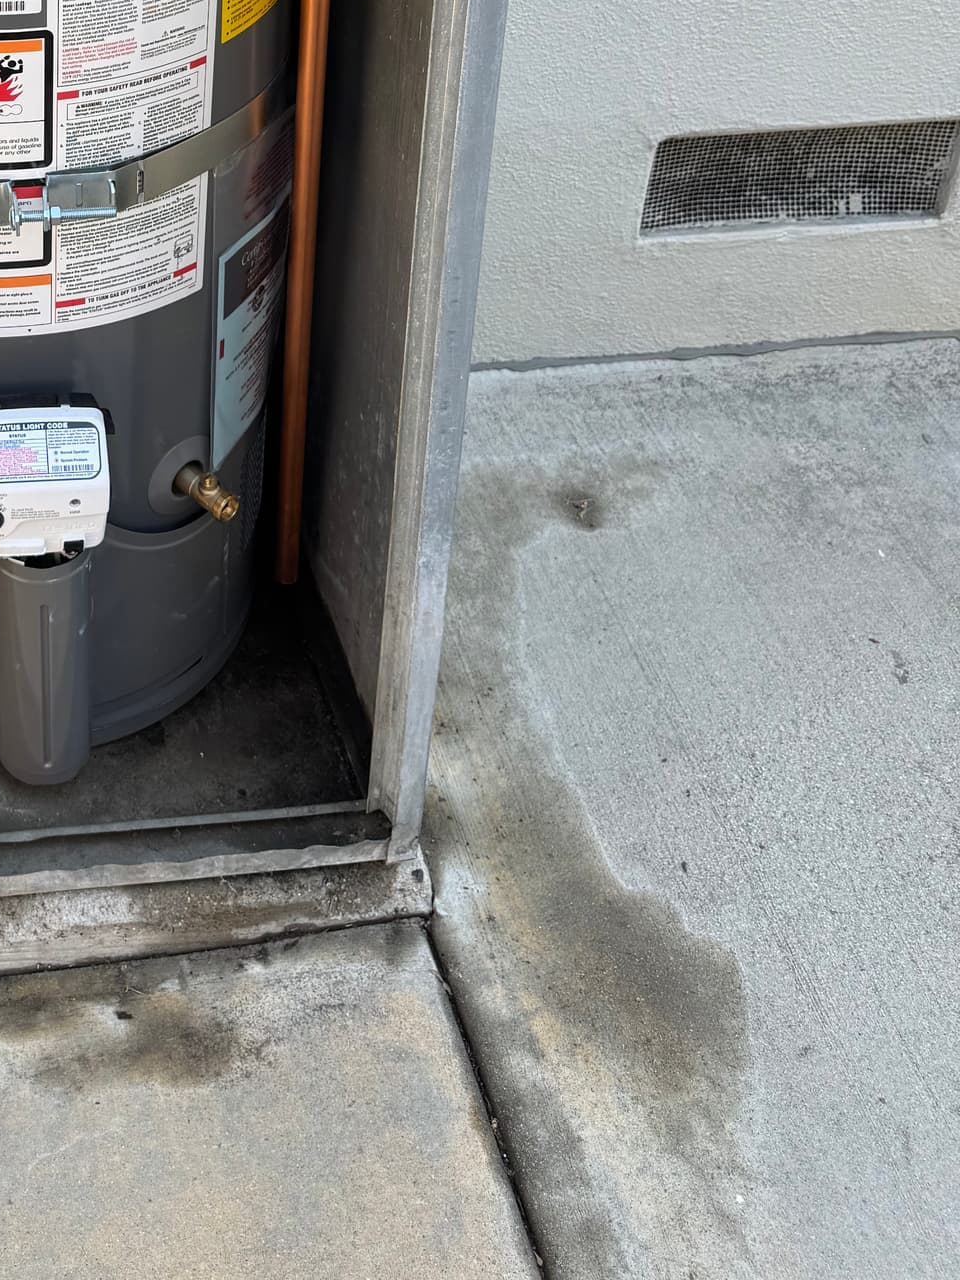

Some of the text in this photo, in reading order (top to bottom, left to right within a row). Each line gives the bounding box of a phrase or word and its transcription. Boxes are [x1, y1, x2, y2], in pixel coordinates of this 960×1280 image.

[94, 87, 108, 95] YOUR
[109, 84, 128, 92] SAFETY
[130, 80, 143, 88] READ
[144, 74, 162, 84] BEFORE
[162, 66, 188, 78] OPERATING
[96, 294, 109, 302] TURN
[147, 275, 172, 288] APPLIANCE
